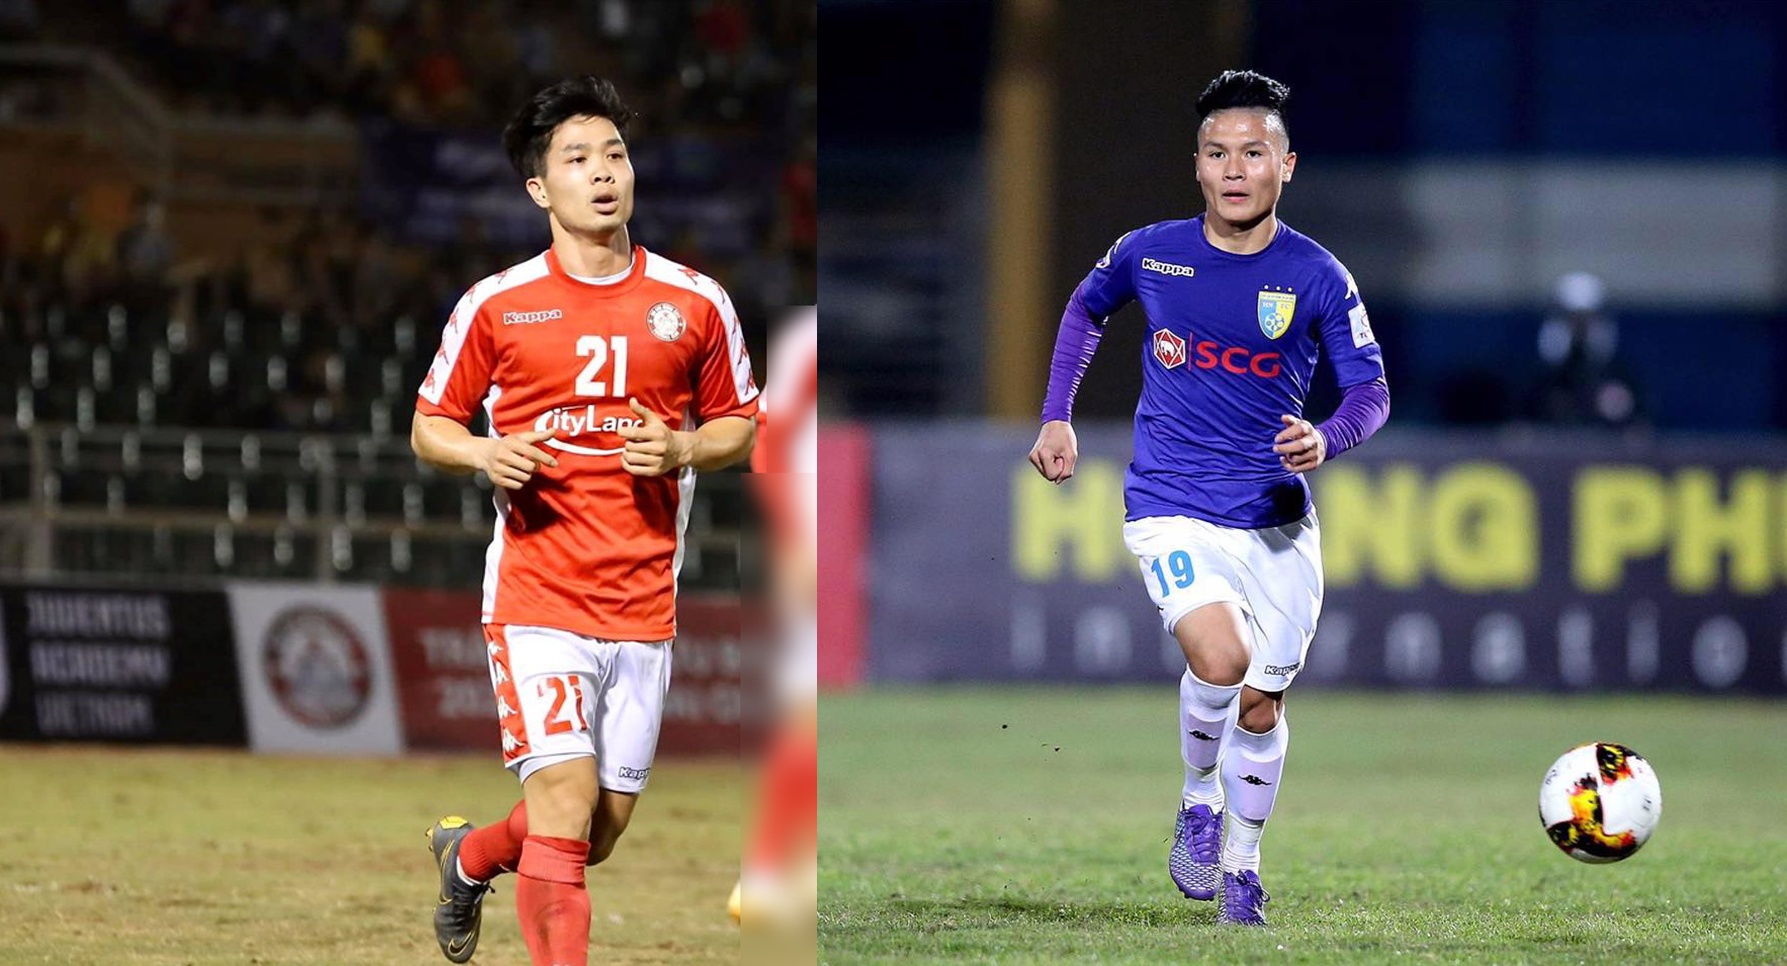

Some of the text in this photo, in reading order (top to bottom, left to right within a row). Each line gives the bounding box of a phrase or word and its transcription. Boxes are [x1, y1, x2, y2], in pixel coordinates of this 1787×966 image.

[1141, 257, 1195, 278] Kappa
[503, 308, 563, 325] Kappa
[574, 334, 628, 398] 21
[1195, 341, 1281, 378] SCG
[534, 404, 643, 437] CityLan
[1011, 460, 1787, 597] HNG PH
[1151, 549, 1195, 598] 19
[536, 674, 587, 736] 21
